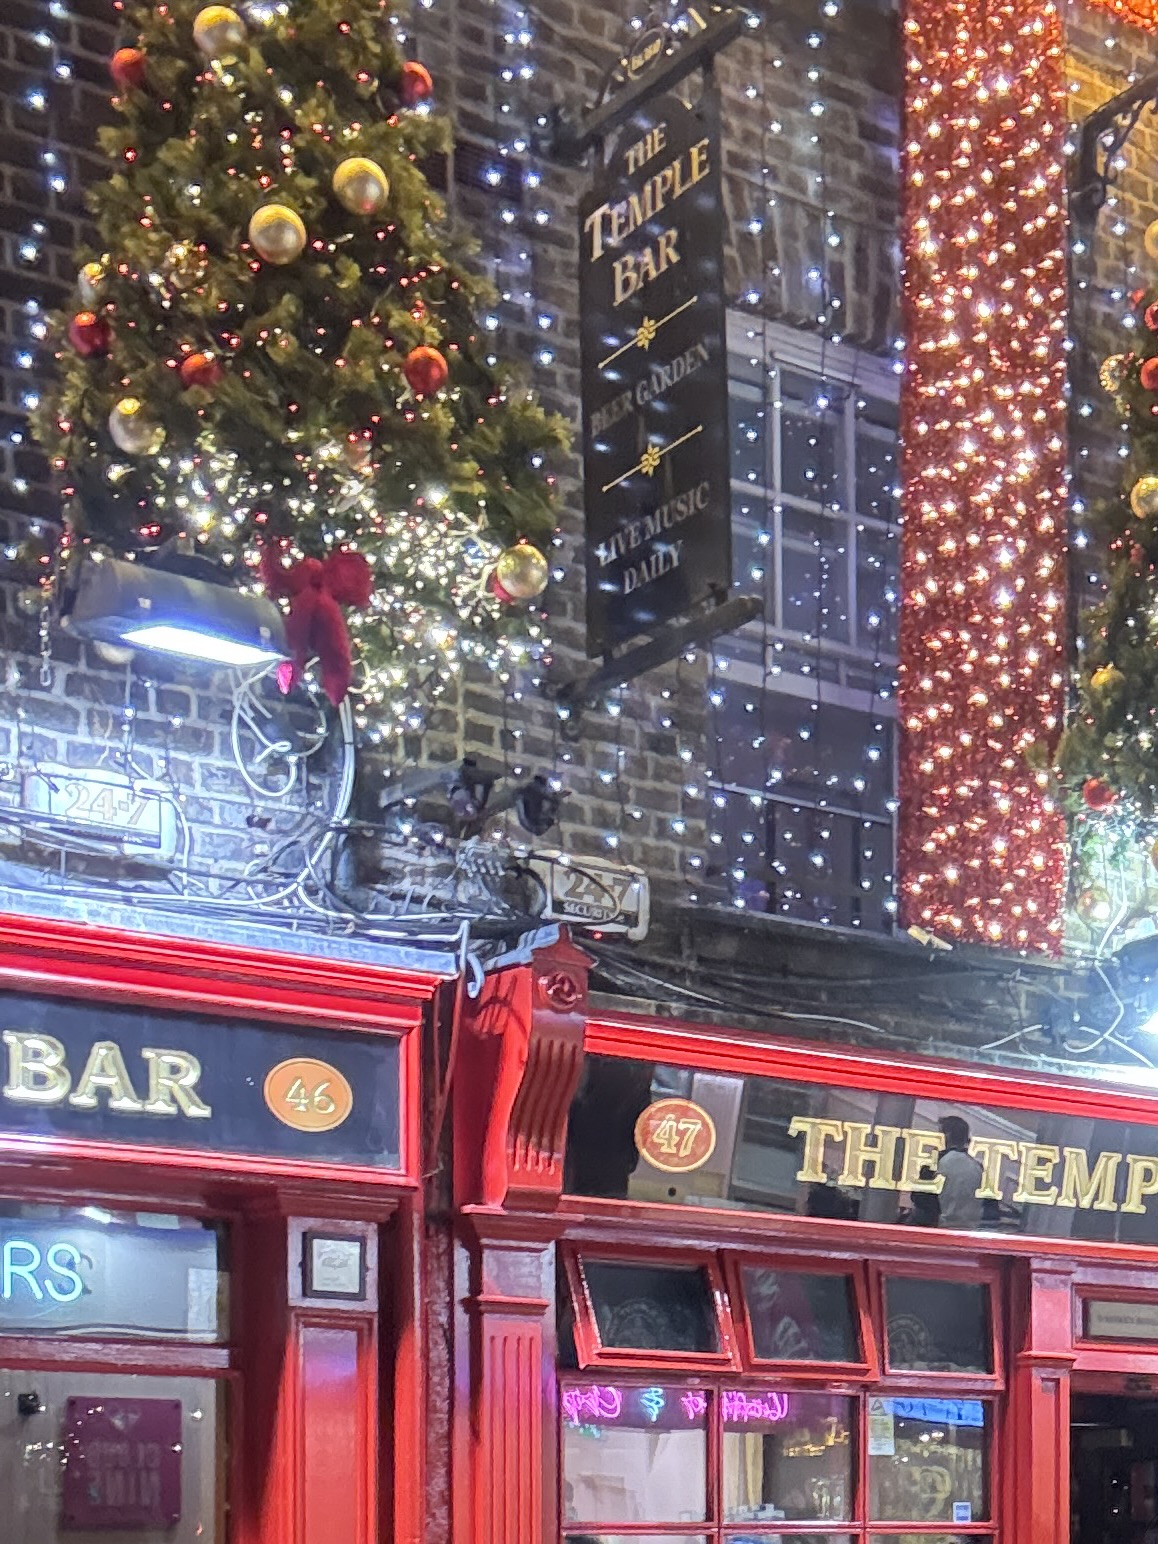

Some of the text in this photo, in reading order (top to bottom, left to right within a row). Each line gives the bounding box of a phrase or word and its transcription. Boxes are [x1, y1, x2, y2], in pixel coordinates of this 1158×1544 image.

[624, 122, 666, 175] THE
[584, 137, 710, 262] TEMPLE
[612, 228, 681, 306] BAR
[644, 481, 709, 540] MUSIC
[624, 540, 683, 594] DAILY
[2, 1030, 211, 1118] BAR
[285, 1076, 335, 1114] 46
[652, 1114, 702, 1157] 47
[787, 1116, 946, 1194] THE
[3, 1240, 83, 1302] RS
